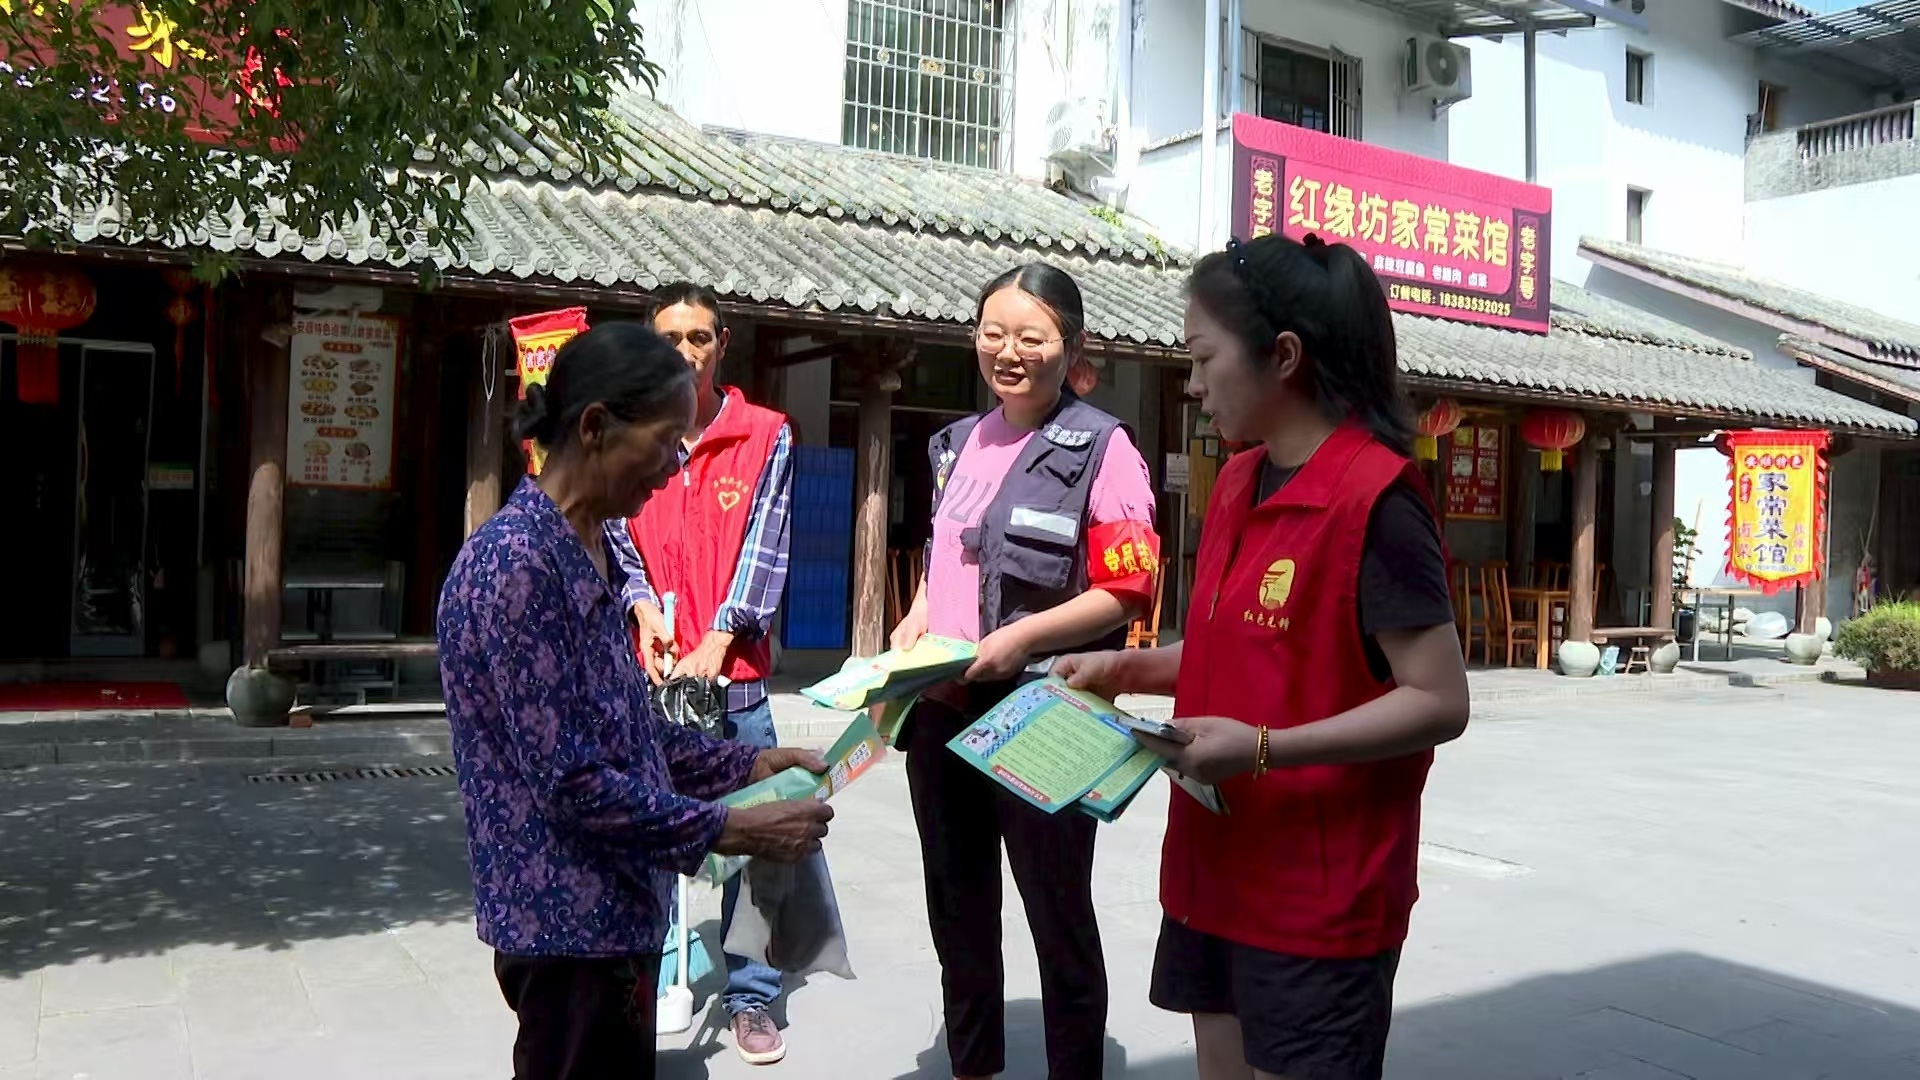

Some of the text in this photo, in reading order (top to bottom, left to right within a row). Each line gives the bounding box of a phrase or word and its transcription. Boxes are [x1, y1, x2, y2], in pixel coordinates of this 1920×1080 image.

[1287, 175, 1510, 268] 红缘坊家常菜馆
[1518, 225, 1538, 301] 老字号
[1753, 472, 1789, 565] 家常菜馆
